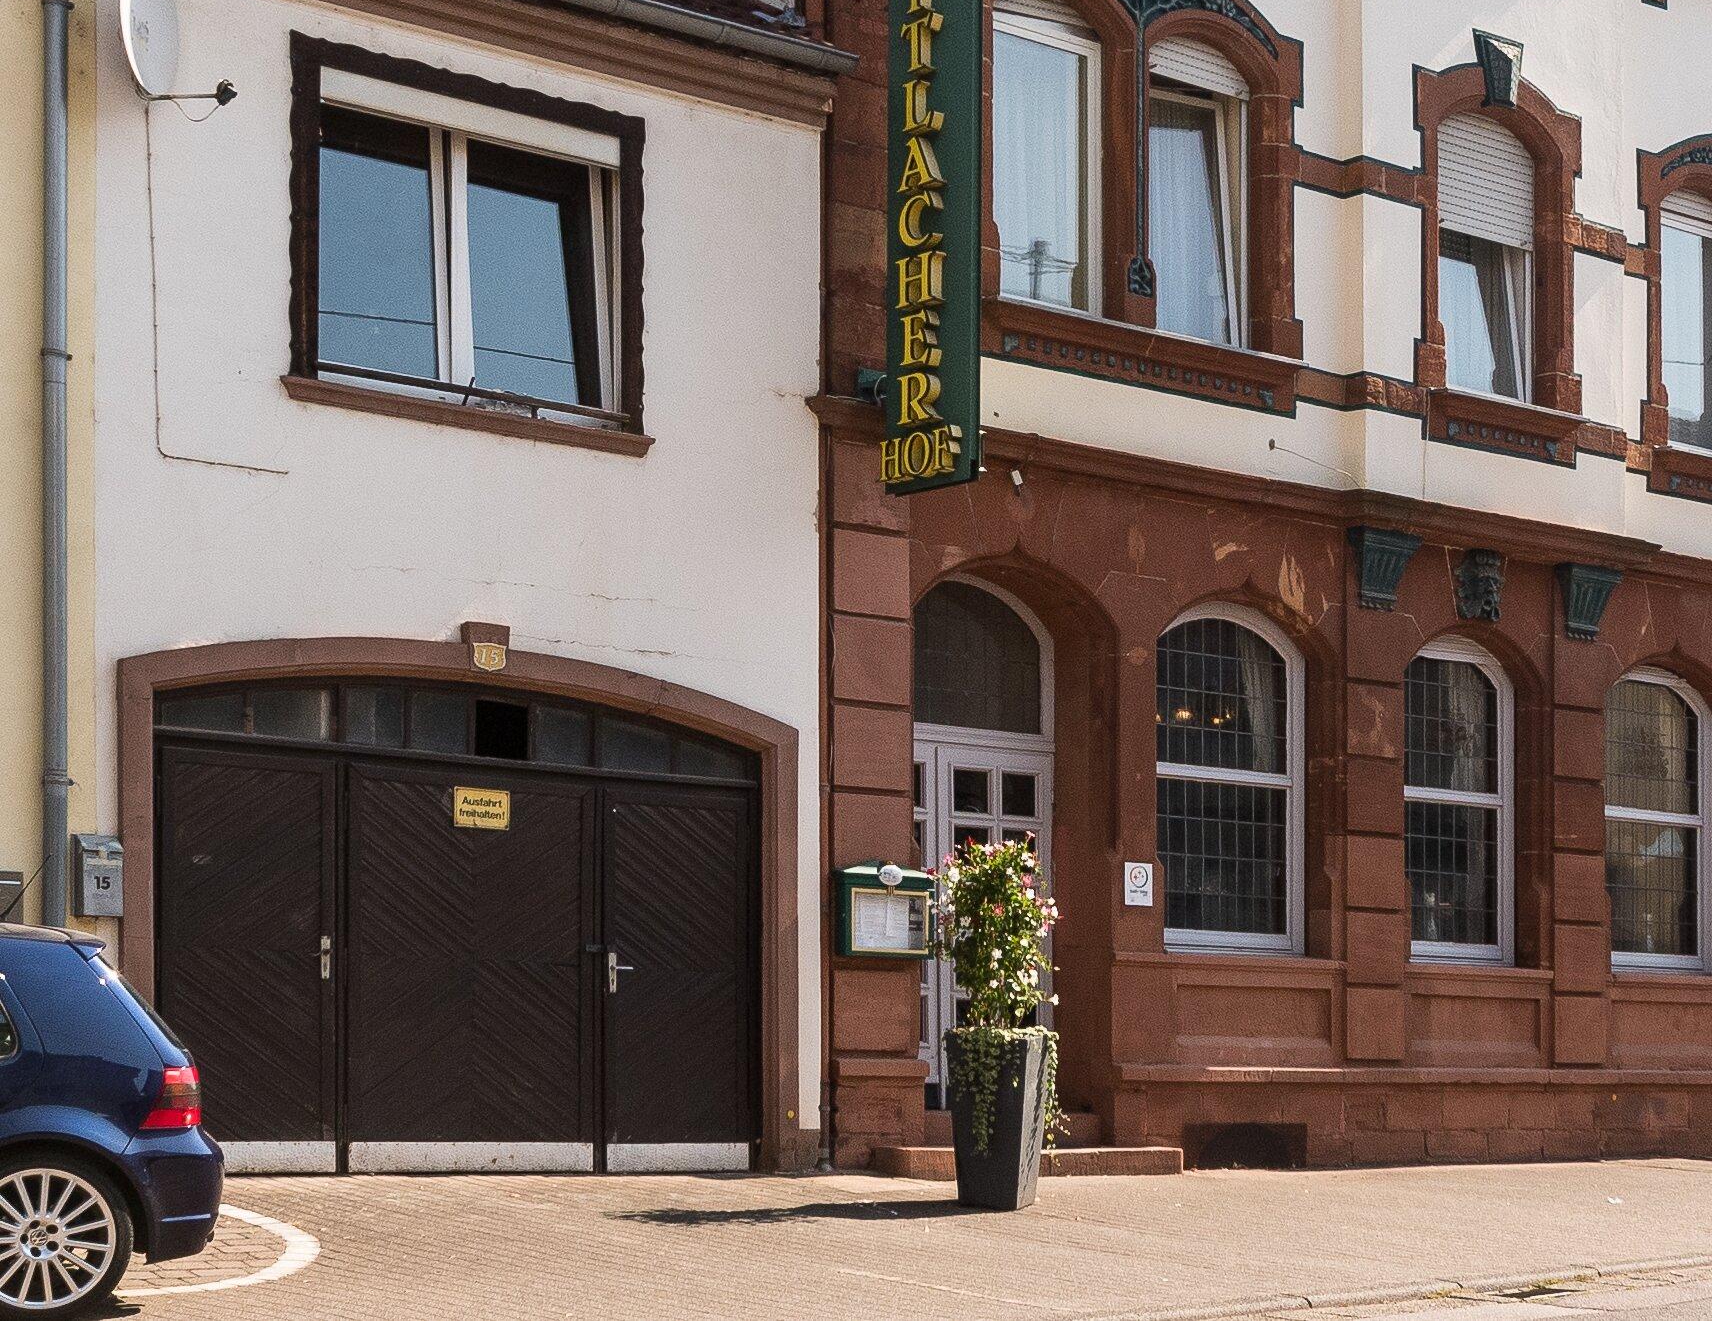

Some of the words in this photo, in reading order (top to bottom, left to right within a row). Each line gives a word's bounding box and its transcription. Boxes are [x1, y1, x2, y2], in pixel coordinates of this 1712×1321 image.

[879, 424, 962, 483] HOF
[462, 796, 502, 808] Ausfahrt
[94, 875, 111, 890] 15
